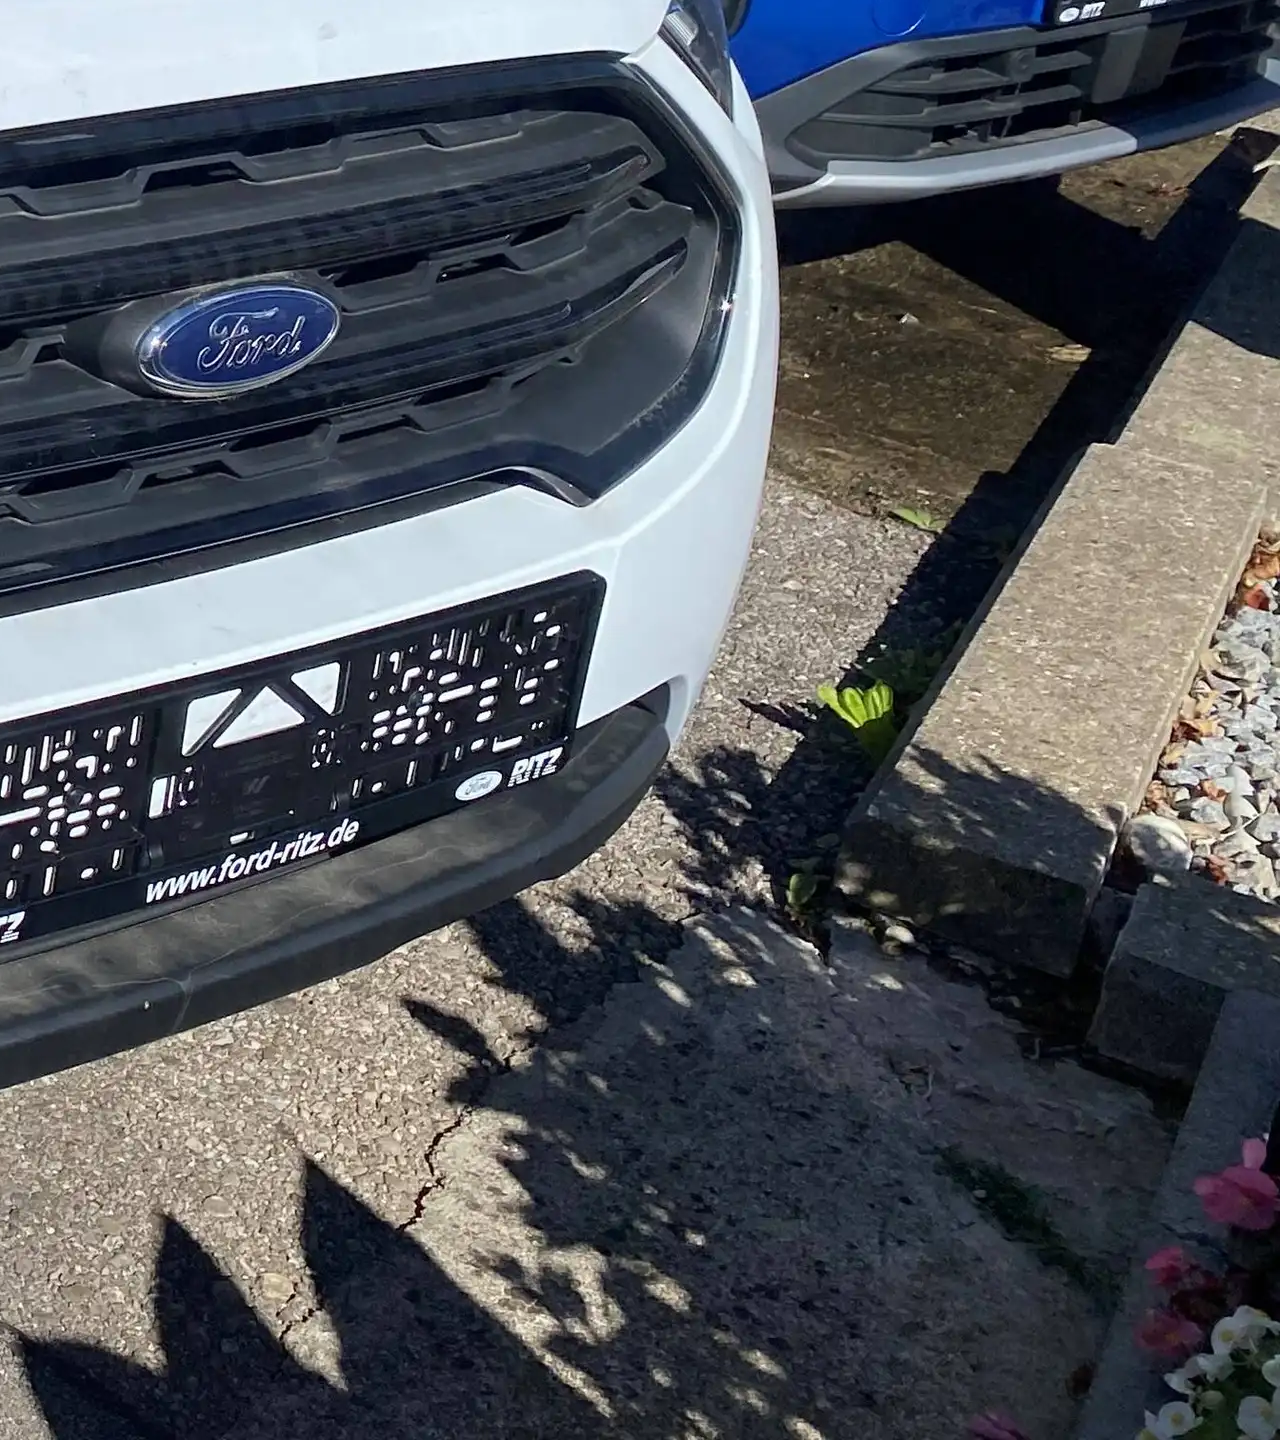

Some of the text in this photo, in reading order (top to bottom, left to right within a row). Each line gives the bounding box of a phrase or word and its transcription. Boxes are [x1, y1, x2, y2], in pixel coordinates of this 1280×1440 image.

[196, 306, 306, 375] Ford
[507, 746, 564, 788] RITZ
[145, 817, 360, 904] www.ford-ritz.de
